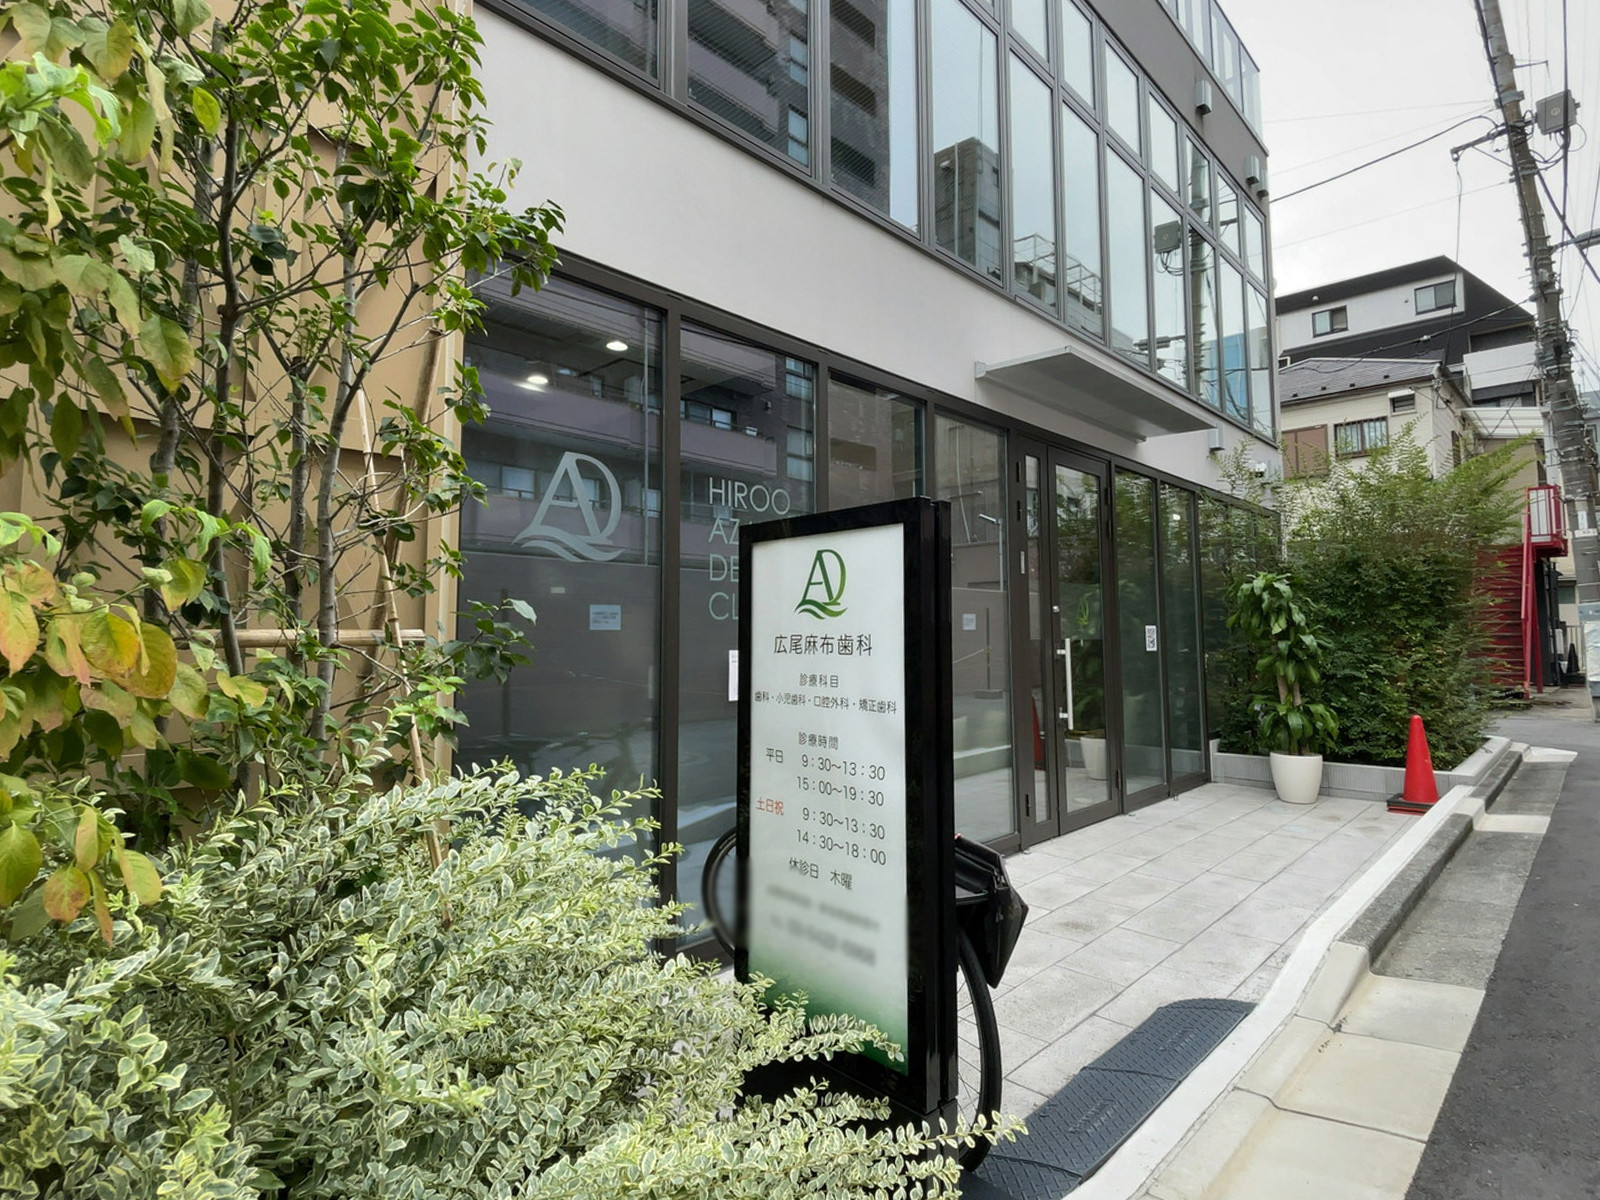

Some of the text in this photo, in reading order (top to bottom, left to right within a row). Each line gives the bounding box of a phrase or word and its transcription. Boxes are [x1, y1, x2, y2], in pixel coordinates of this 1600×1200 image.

[709, 476, 790, 515] HIROO
[708, 517, 740, 545] AZ
[709, 553, 740, 582] DE
[708, 592, 739, 620] CL
[773, 633, 873, 656] 広尾麻布歯科
[799, 672, 839, 688] 診療科目
[798, 732, 839, 750] 診療時間
[766, 747, 784, 763] 平日
[756, 797, 784, 816] 土日祝
[789, 856, 853, 890] 休診日 木曜
